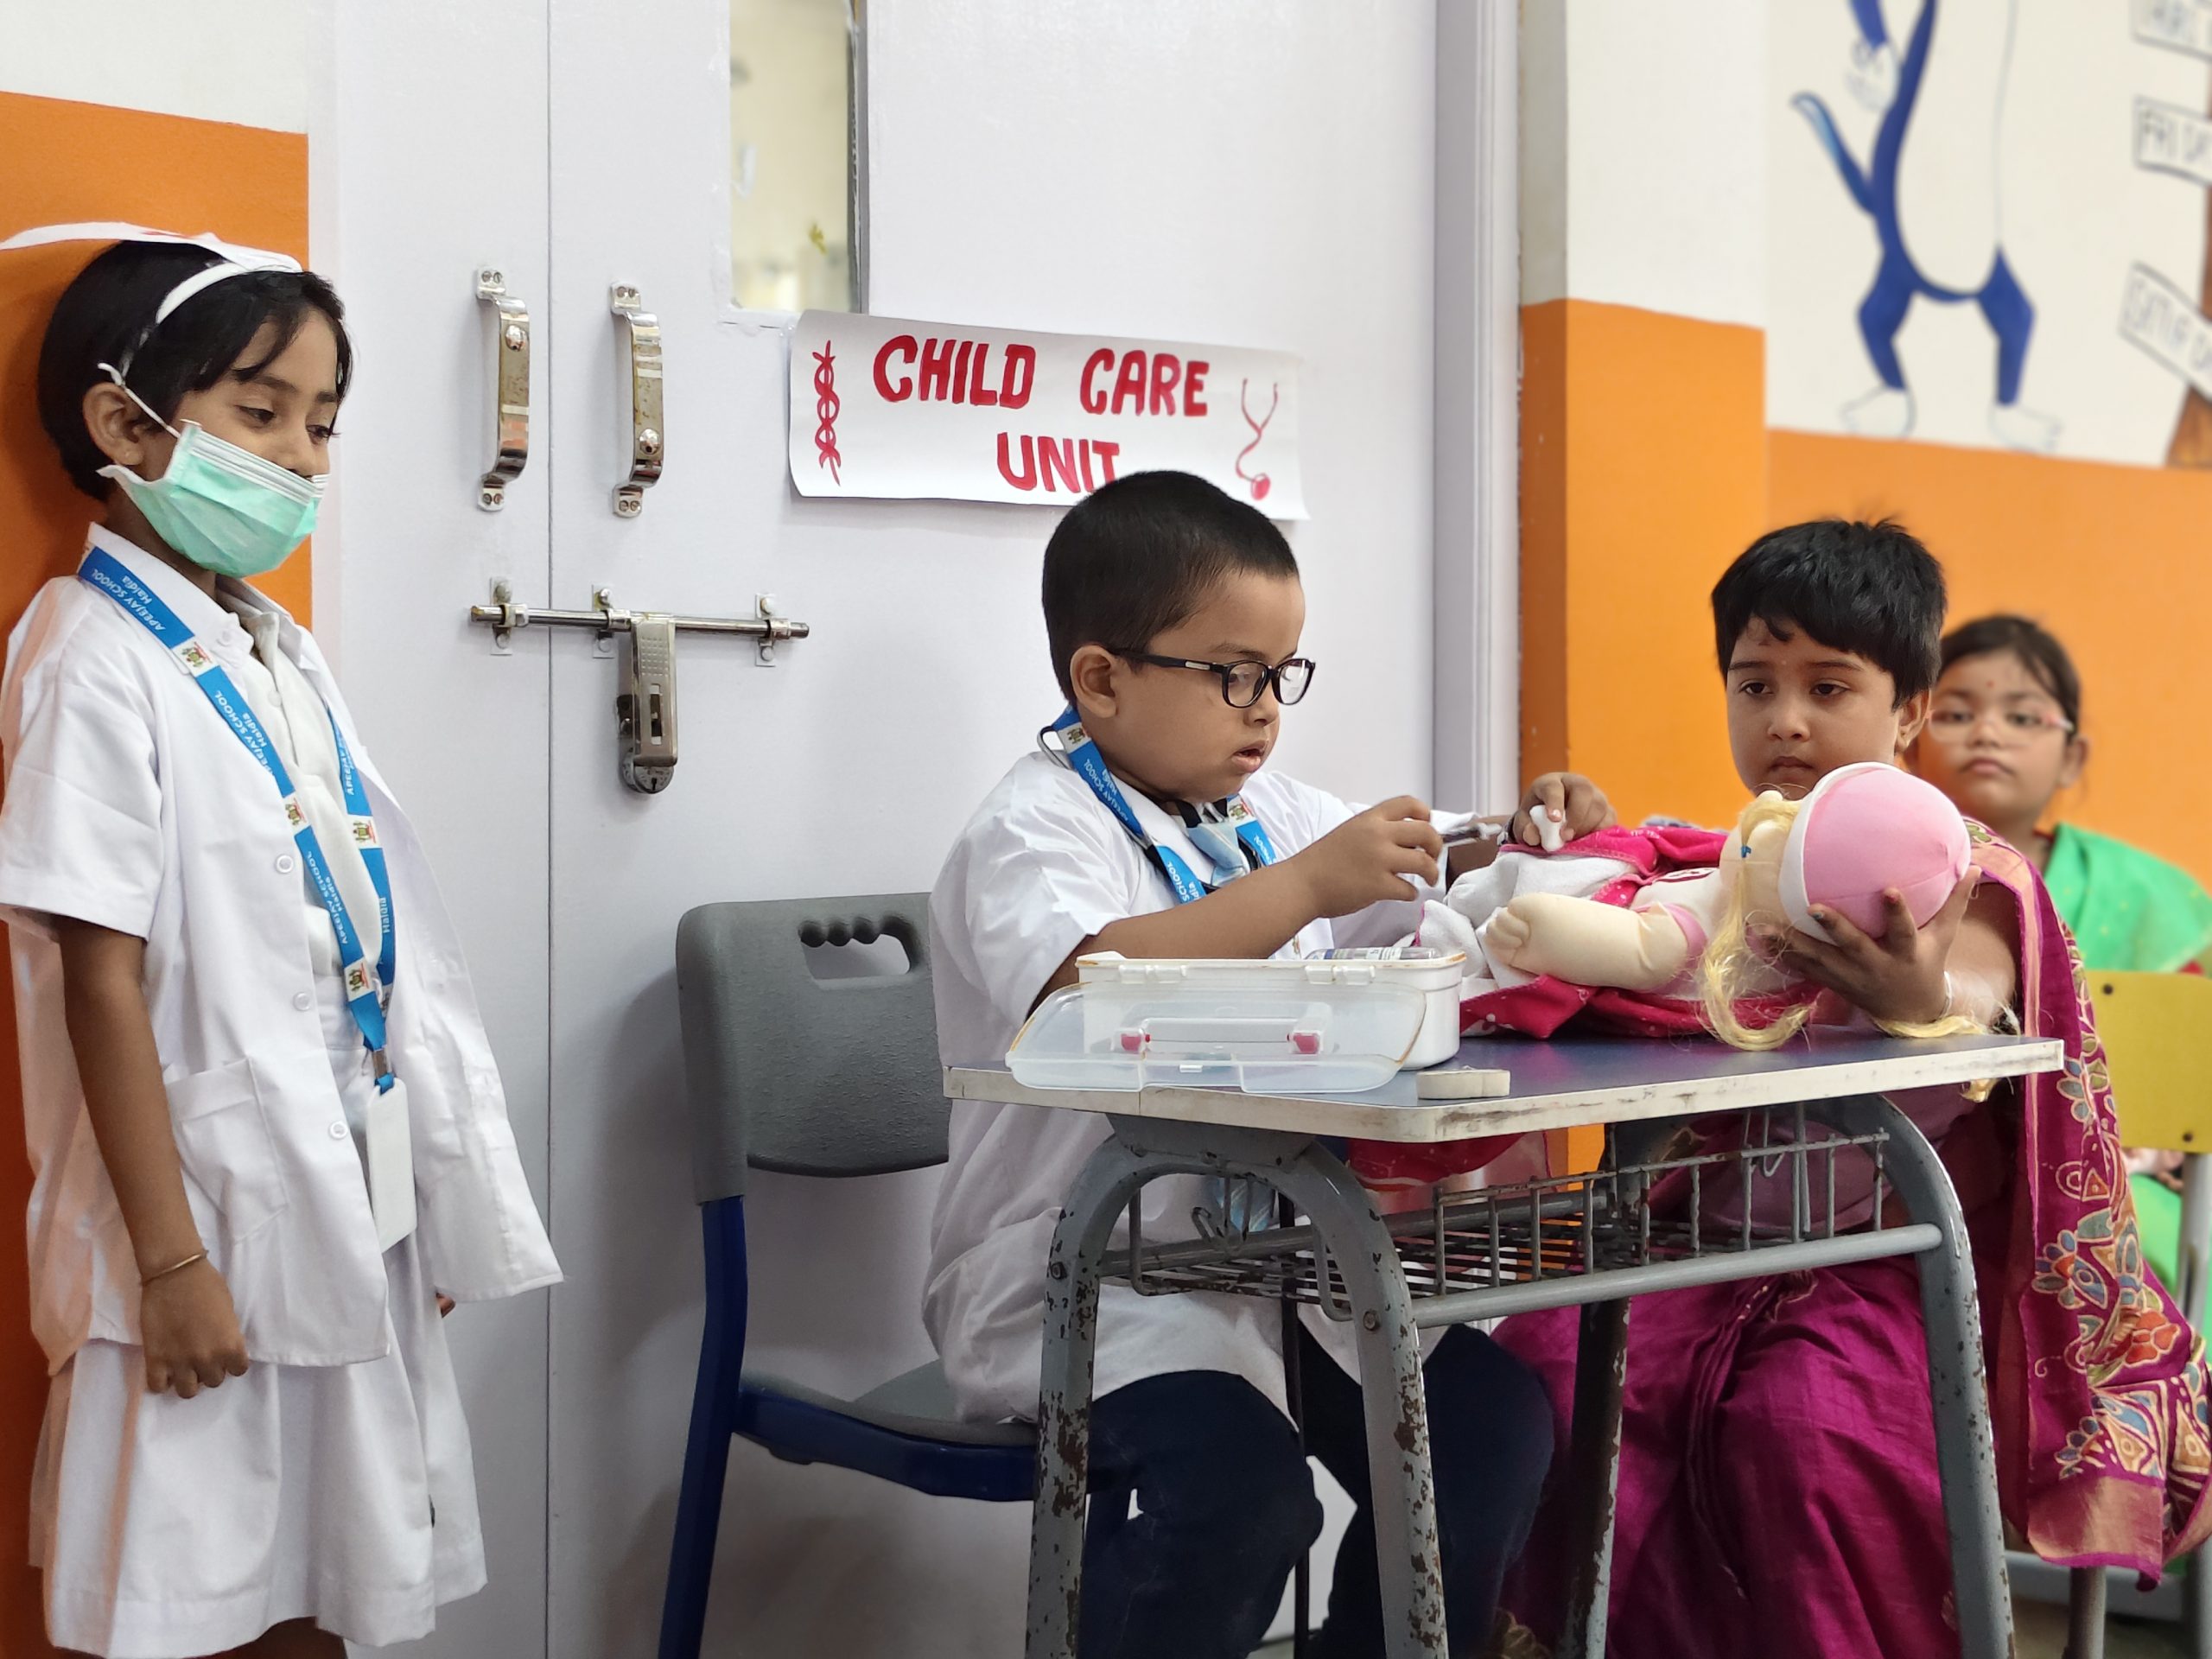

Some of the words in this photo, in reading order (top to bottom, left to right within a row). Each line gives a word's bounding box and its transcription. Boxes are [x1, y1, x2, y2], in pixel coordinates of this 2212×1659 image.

[873, 334, 1036, 410] CHILD
[1080, 348, 1209, 416] CARE
[997, 432, 1120, 493] UNIT
[92, 569, 128, 598] SCHOOL
[122, 575, 152, 604] Haldia
[124, 597, 166, 631] APEEJAY
[214, 690, 248, 734] SCHOOL
[243, 712, 267, 747] Haldia
[1084, 759, 1104, 792] SCHOOL
[307, 851, 329, 898] SCHOOL
[1167, 861, 1190, 902] SCHOOL
[325, 876, 344, 912] Haldia
[327, 899, 348, 944] APEEJAY
